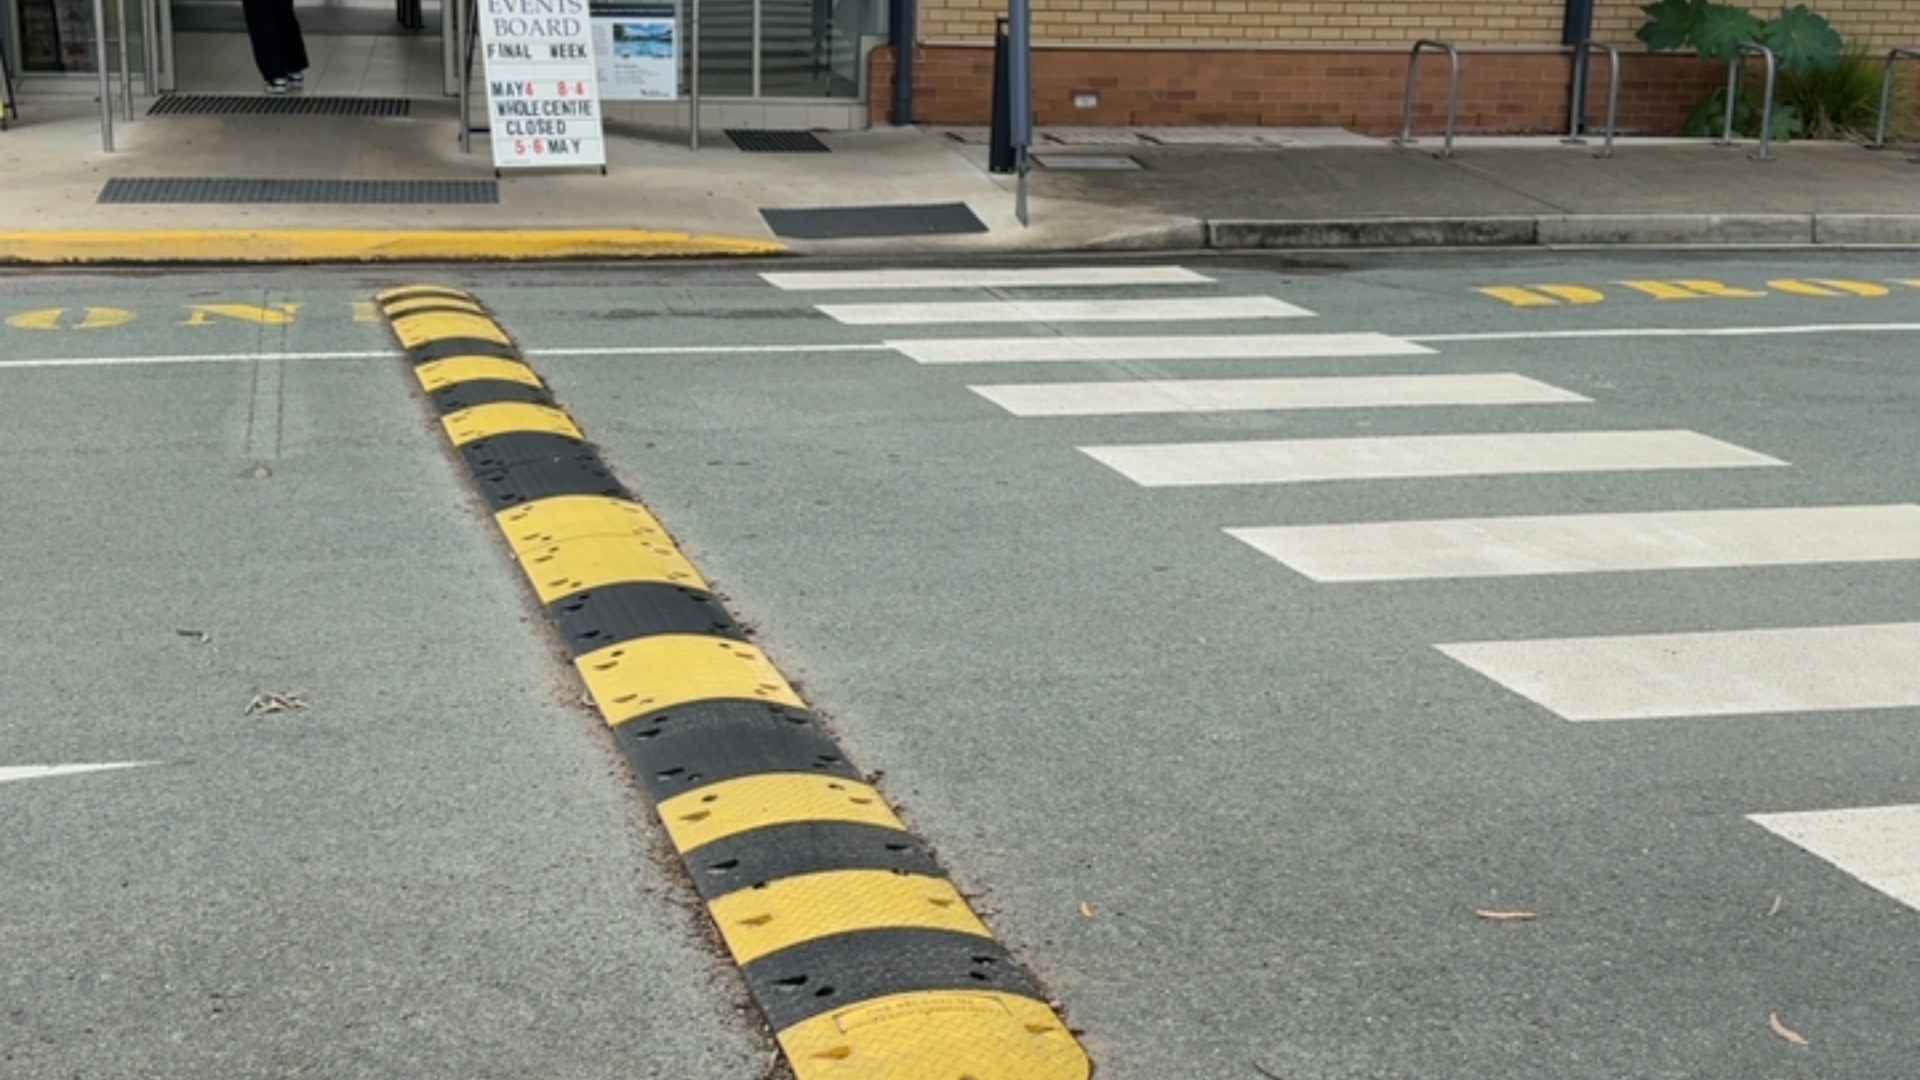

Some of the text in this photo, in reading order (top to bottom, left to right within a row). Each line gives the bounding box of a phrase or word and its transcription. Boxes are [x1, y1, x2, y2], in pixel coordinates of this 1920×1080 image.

[488, 0, 583, 14] EVENTS
[493, 17, 580, 37] BOARD
[487, 43, 588, 59] FINAL WEEK
[506, 119, 567, 135] CLOSED
[548, 138, 580, 154] MAY
[1468, 277, 1920, 307] DRO
